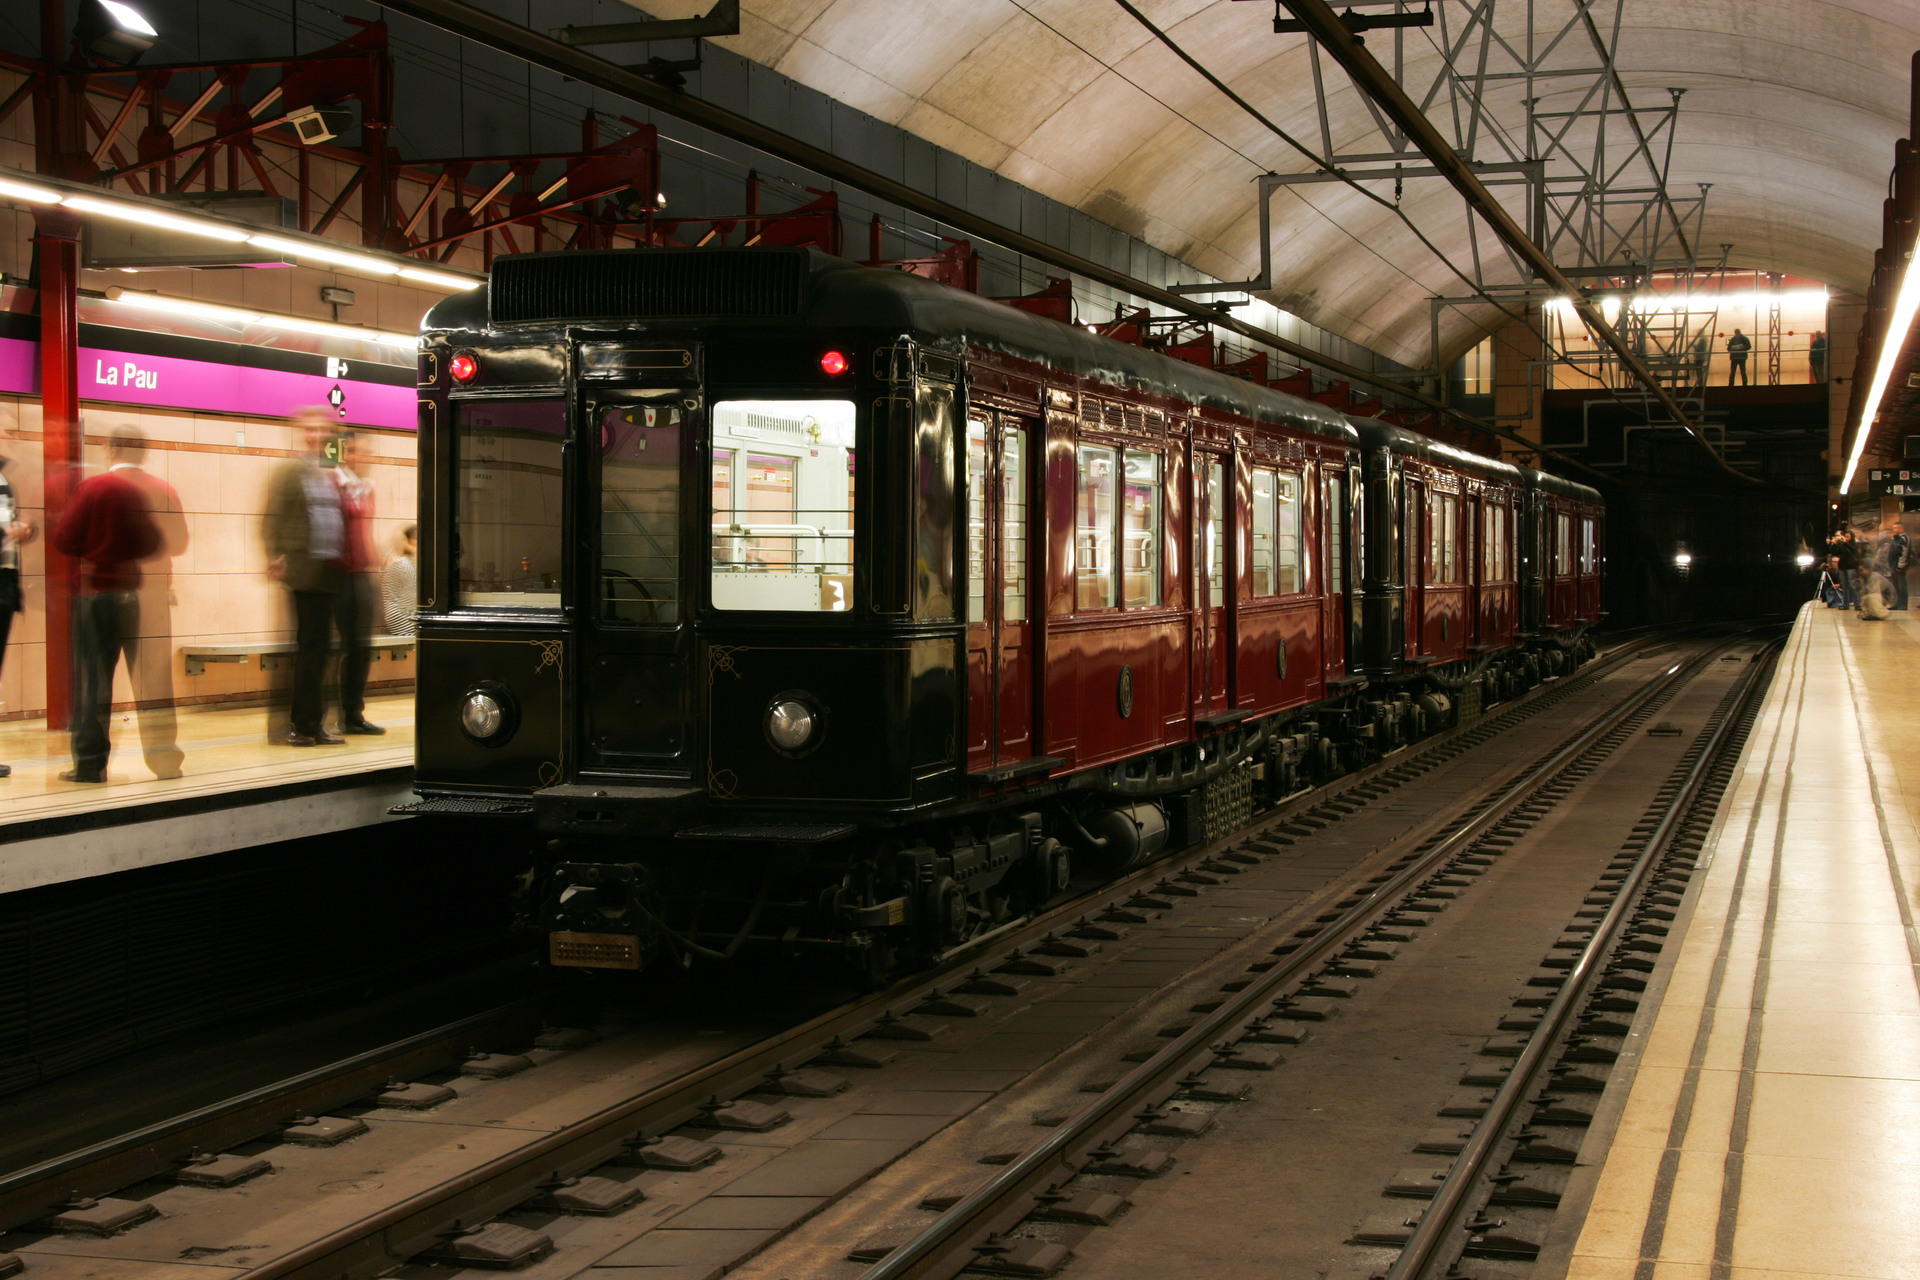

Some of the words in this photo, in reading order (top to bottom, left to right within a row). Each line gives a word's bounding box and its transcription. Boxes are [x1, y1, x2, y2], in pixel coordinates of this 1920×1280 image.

[96, 359, 118, 385] La
[123, 362, 158, 389] Pau
[331, 389, 341, 405] M
